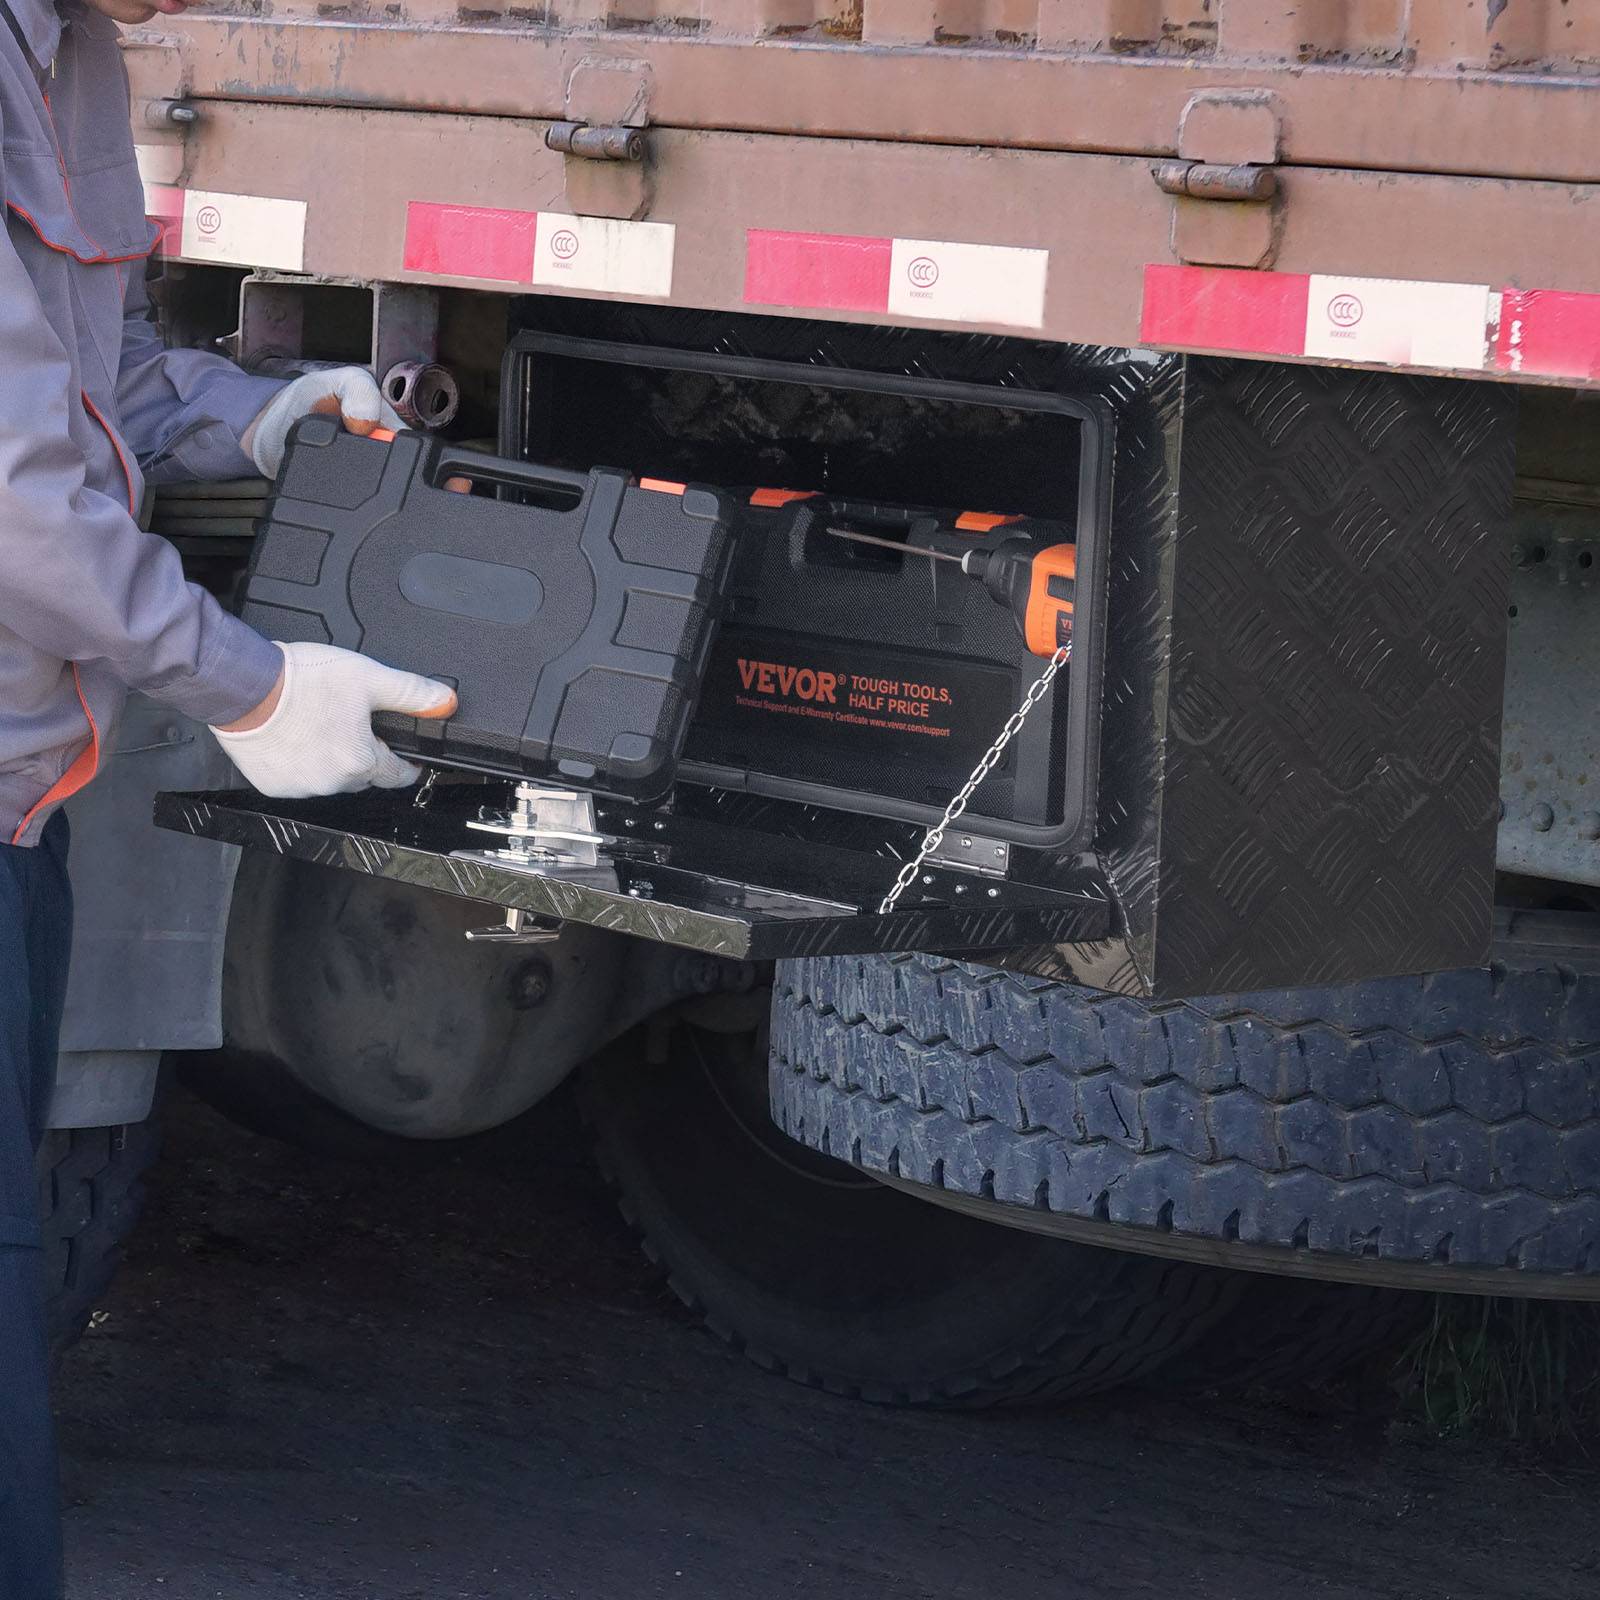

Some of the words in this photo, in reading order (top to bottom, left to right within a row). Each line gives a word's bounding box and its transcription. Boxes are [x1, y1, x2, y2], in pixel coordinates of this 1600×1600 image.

[850, 675, 899, 695] TOUGH
[902, 682, 953, 705] TOOLS,
[736, 695, 762, 708] Technical
[763, 700, 787, 713] Support
[788, 705, 799, 715] and
[836, 711, 868, 725] Certificate
[848, 693, 884, 711] HALF
[888, 698, 929, 718] PRICE
